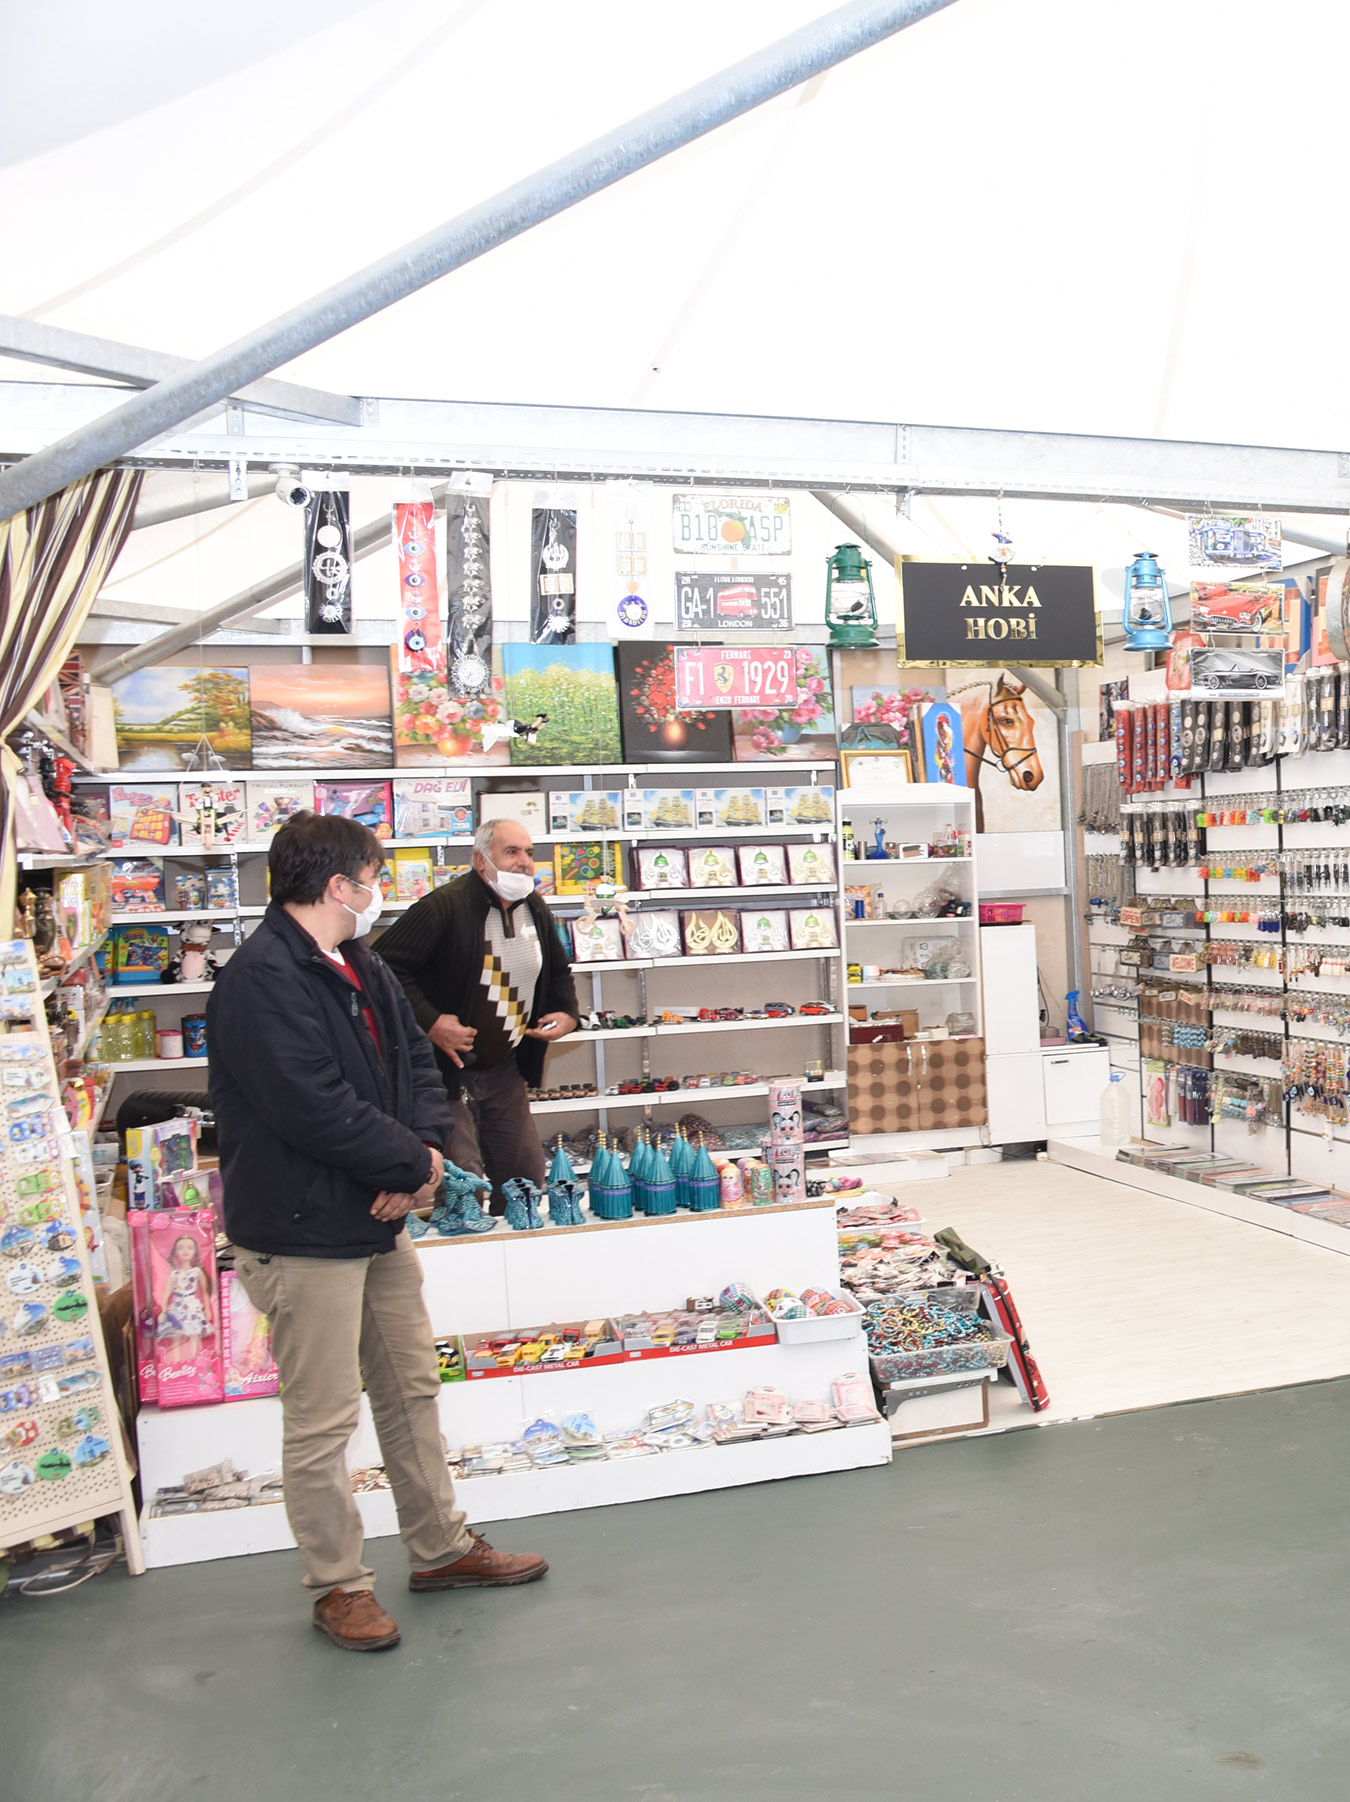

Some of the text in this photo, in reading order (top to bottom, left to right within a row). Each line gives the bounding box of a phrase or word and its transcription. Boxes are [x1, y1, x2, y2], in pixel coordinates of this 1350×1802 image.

[704, 499, 763, 513] FLORIDA
[749, 515, 783, 542] ASP
[701, 542, 738, 552] SUNSHINE
[959, 584, 1042, 607] ANKA
[760, 587, 788, 619] 551
[718, 620, 753, 628] LONDON
[965, 612, 1038, 640] HOBİ
[721, 650, 751, 660] FERRARI
[684, 661, 789, 696] F1 1929
[715, 695, 760, 704] ENZO FERRARI
[414, 779, 468, 793] DAĞ EVİ
[1122, 913, 1140, 924] OPEN
[669, 1343, 697, 1352] DIE-CAST
[699, 1341, 720, 1349] METAL
[513, 1360, 580, 1372] DIE-CAST METAL CAR
